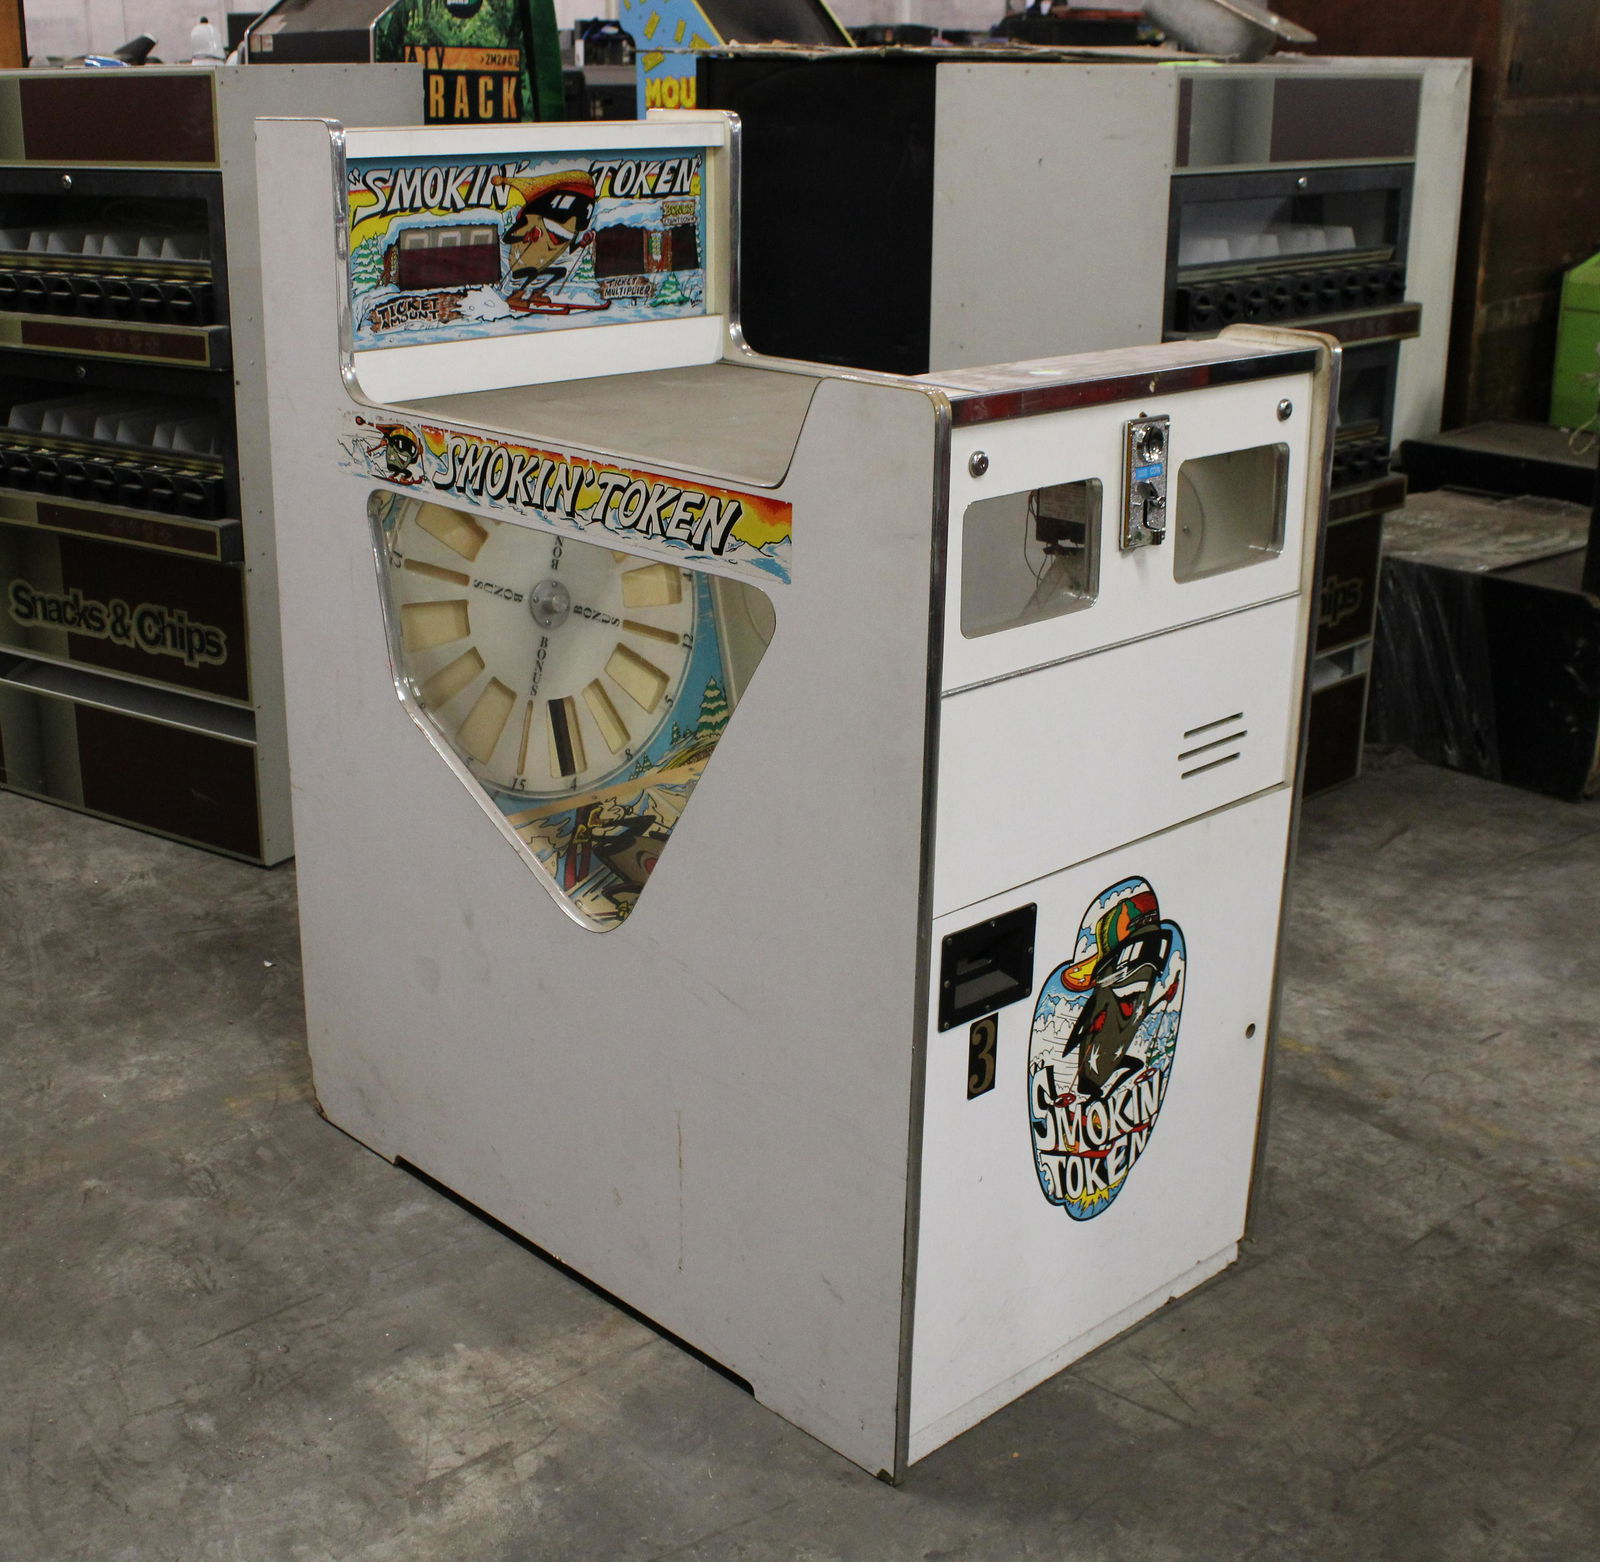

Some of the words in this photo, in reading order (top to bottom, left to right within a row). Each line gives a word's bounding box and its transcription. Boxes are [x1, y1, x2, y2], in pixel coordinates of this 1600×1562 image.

[605, 285, 651, 297] MULTIPLIER
[607, 277, 638, 287] TICKET
[377, 297, 440, 321] TICKET
[381, 310, 440, 330] AMOUNT
[432, 437, 596, 518] SMOKIN'
[589, 470, 743, 556] TOKEN
[473, 578, 524, 603] BONUS
[9, 579, 109, 640] Snacks
[109, 599, 136, 648] &
[133, 603, 228, 669] Chips
[573, 604, 621, 628] BONUS
[530, 635, 549, 696] BONUS
[511, 777, 527, 792] 15
[969, 1017, 996, 1096] 3
[1039, 1129, 1149, 1200] TOKEN
